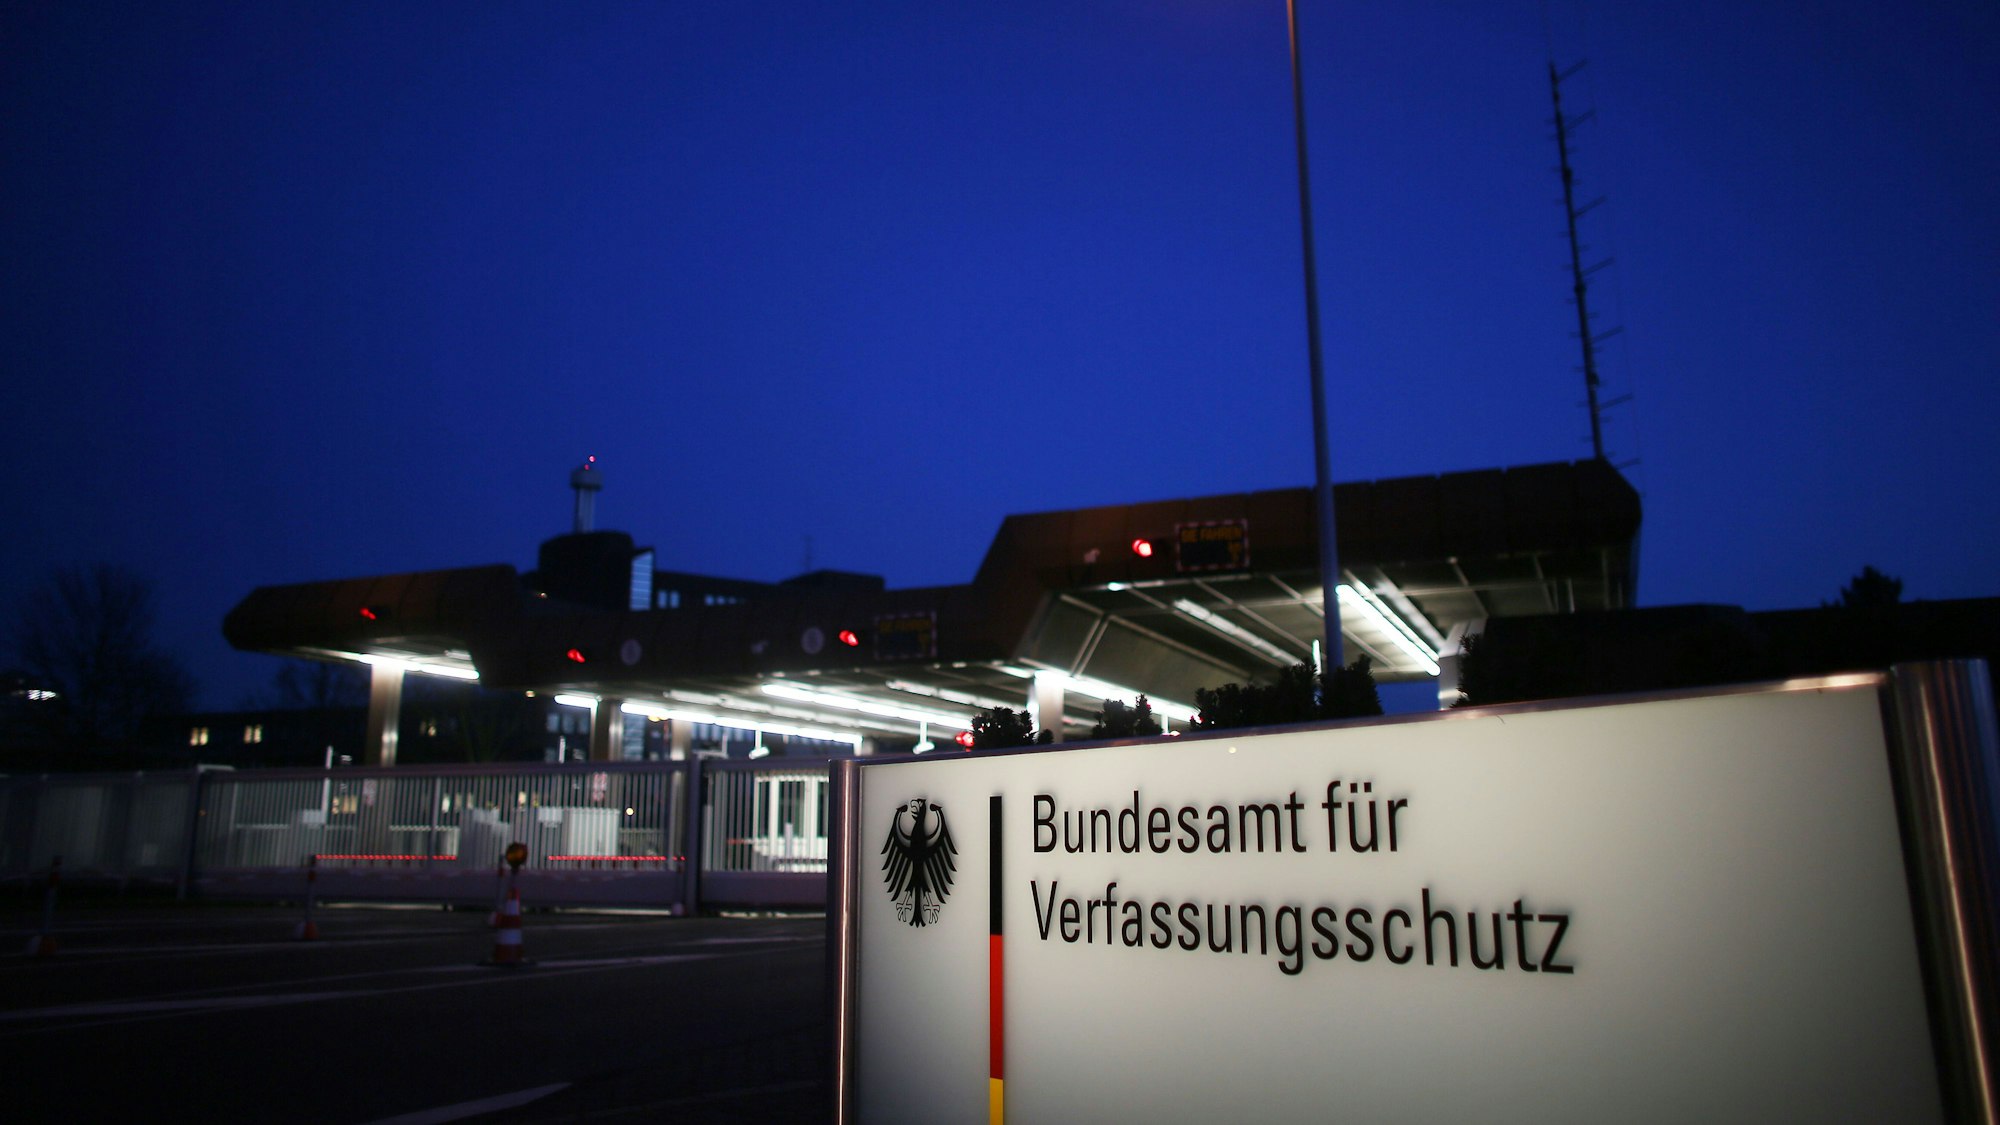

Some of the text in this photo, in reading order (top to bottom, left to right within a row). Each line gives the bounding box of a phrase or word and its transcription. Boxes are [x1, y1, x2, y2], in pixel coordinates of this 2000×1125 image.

[1033, 779, 1409, 854] Bundesamt für
[1030, 880, 1575, 976] Verfassungsschutz
